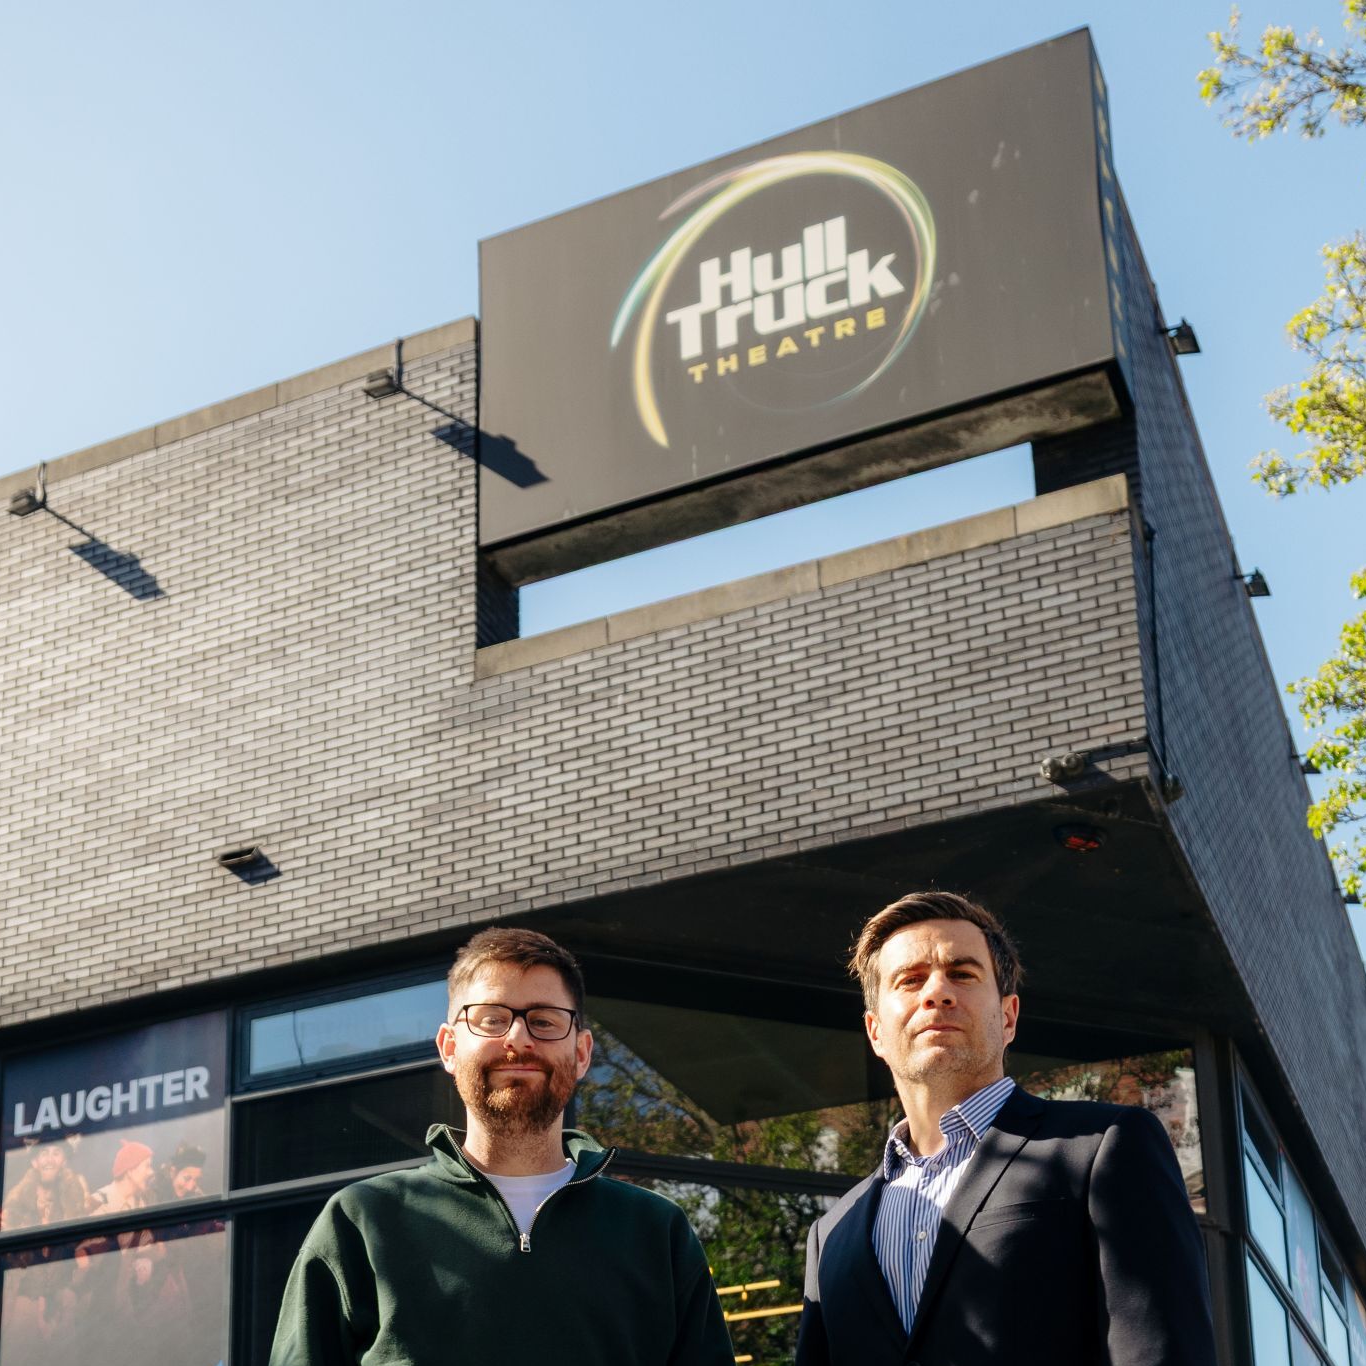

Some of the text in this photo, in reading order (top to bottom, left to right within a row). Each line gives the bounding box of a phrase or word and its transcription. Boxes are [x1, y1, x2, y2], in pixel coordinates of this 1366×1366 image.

[699, 216, 847, 304] Hull
[666, 248, 905, 361] Truck
[687, 306, 886, 384] THEATRE
[13, 1065, 210, 1137] LAUGHTER
